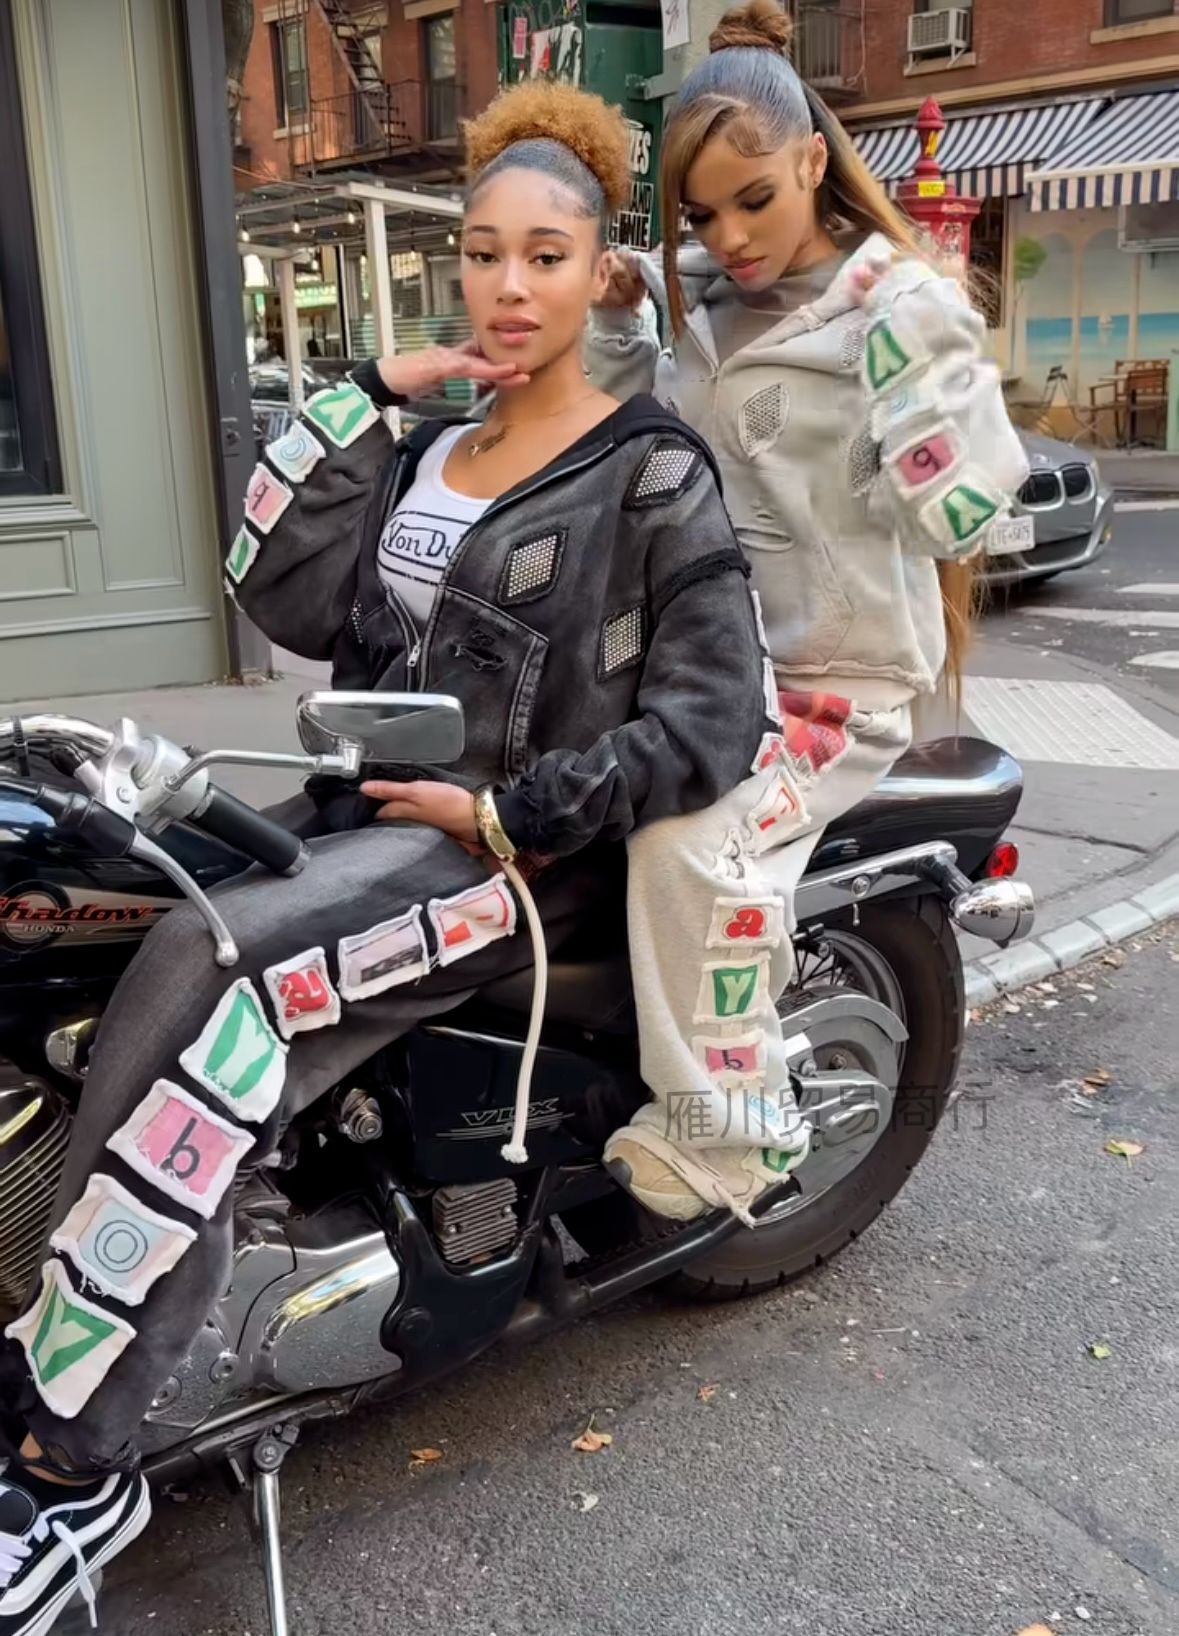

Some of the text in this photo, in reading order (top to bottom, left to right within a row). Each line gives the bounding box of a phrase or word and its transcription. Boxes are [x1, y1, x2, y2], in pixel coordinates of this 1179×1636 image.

[387, 520, 421, 557] Von
[24, 924, 74, 933] HONDA
[723, 906, 766, 940] a
[721, 971, 755, 1014] Y
[162, 1117, 201, 1181] b
